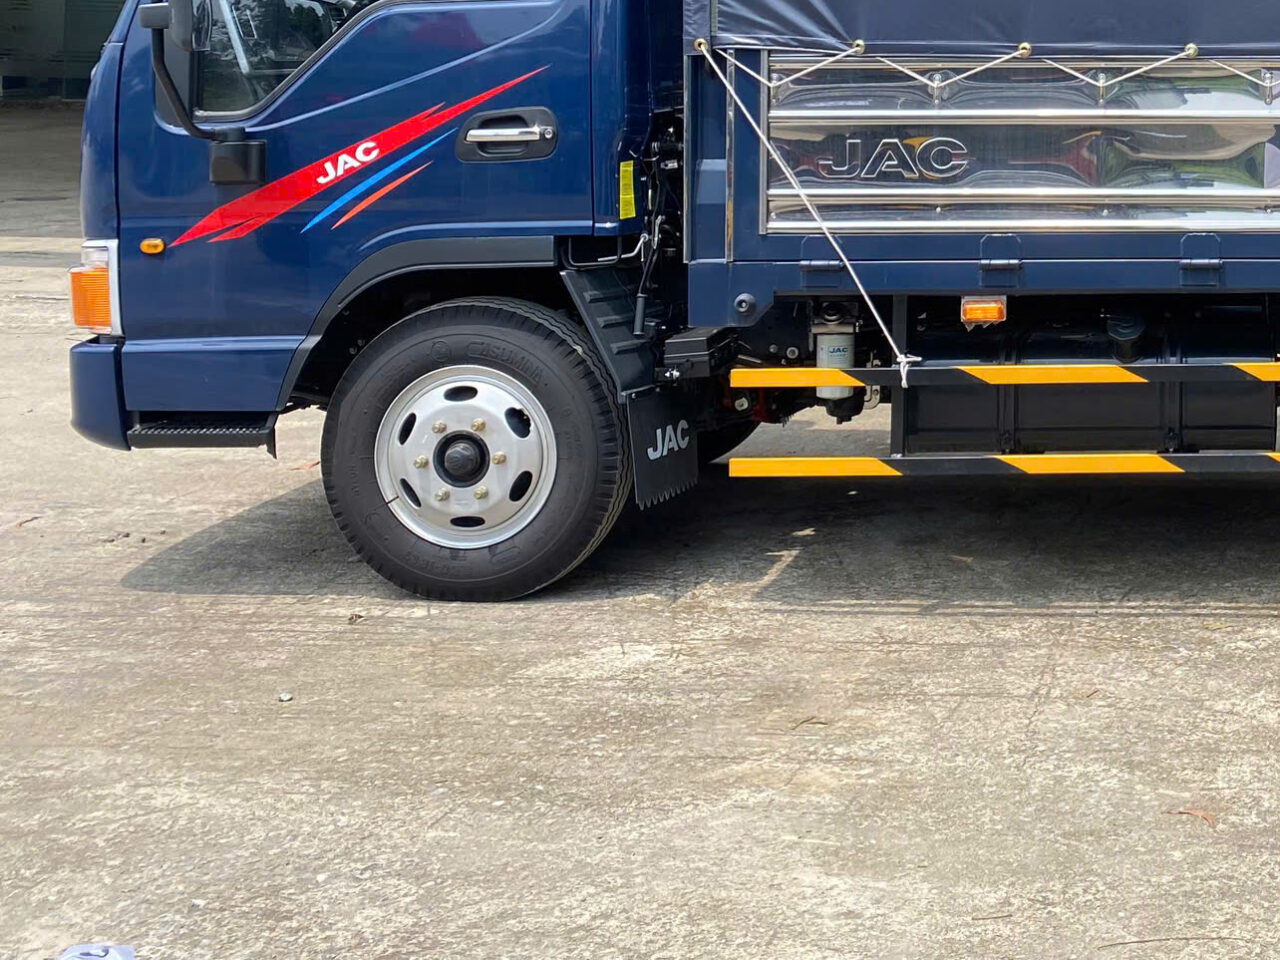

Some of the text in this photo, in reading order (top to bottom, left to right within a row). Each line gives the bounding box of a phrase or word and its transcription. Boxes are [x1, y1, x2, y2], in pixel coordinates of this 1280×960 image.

[316, 141, 380, 184] JAC
[817, 137, 968, 178] JAC
[647, 419, 690, 460] JAC
